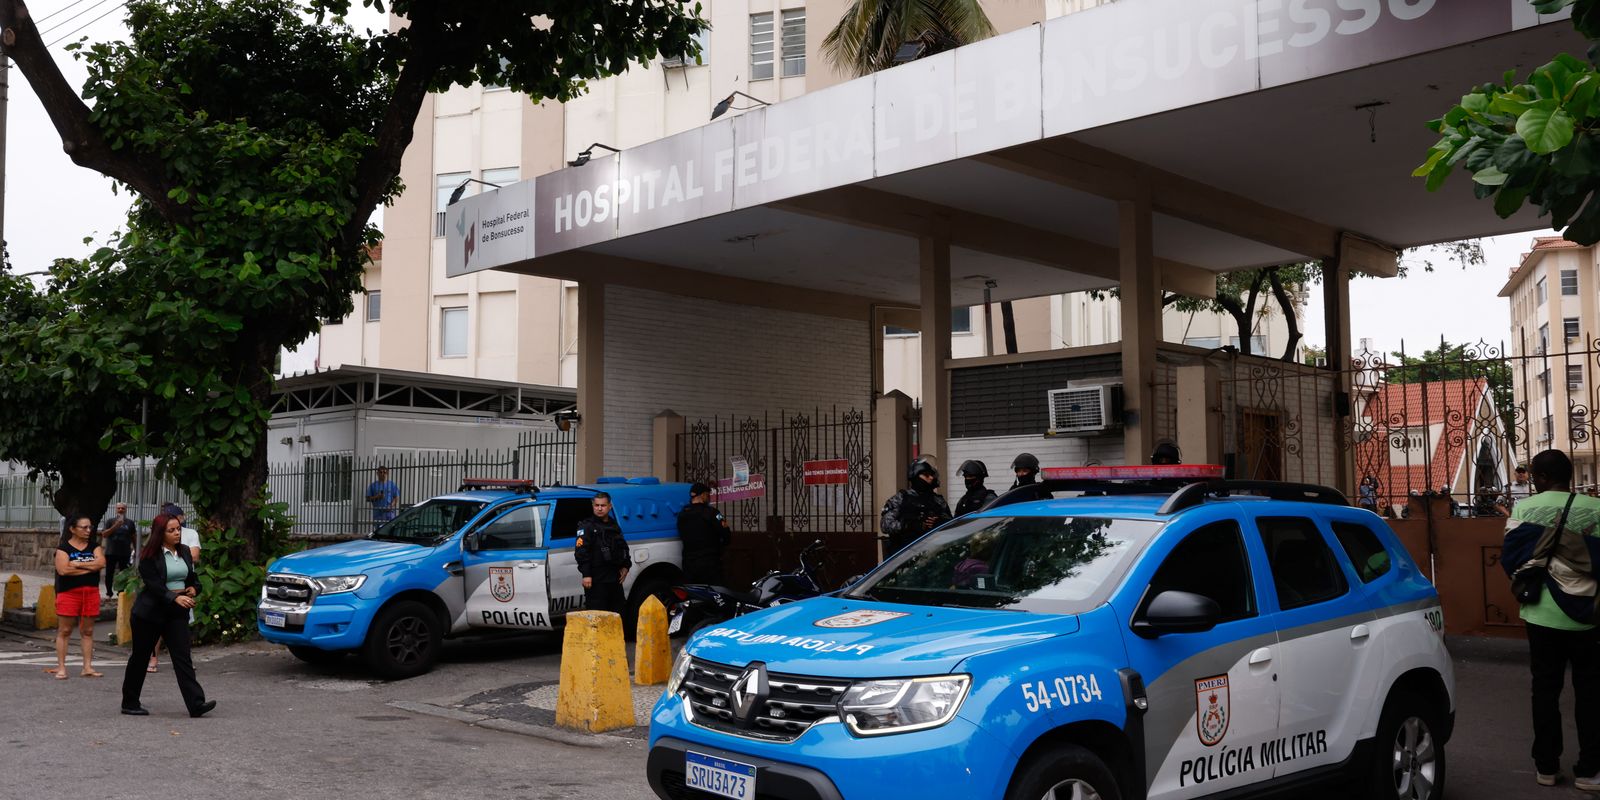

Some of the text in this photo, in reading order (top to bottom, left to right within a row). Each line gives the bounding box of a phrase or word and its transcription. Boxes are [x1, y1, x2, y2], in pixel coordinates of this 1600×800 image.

[555, 159, 703, 233] HOSPITAL
[714, 104, 901, 192] FEDERAL
[914, 79, 978, 142] DE
[481, 225, 524, 243] de Bonsucesso
[482, 208, 530, 229] Hospital Federal
[481, 594, 585, 627] POLÍCIA MILI
[1424, 610, 1442, 632] 190
[1021, 673, 1102, 713] 54-0734
[1198, 678, 1226, 690] PMERJ
[1179, 729, 1328, 787] POLÍCIA MILITAR
[691, 765, 746, 798] SRU3A73
